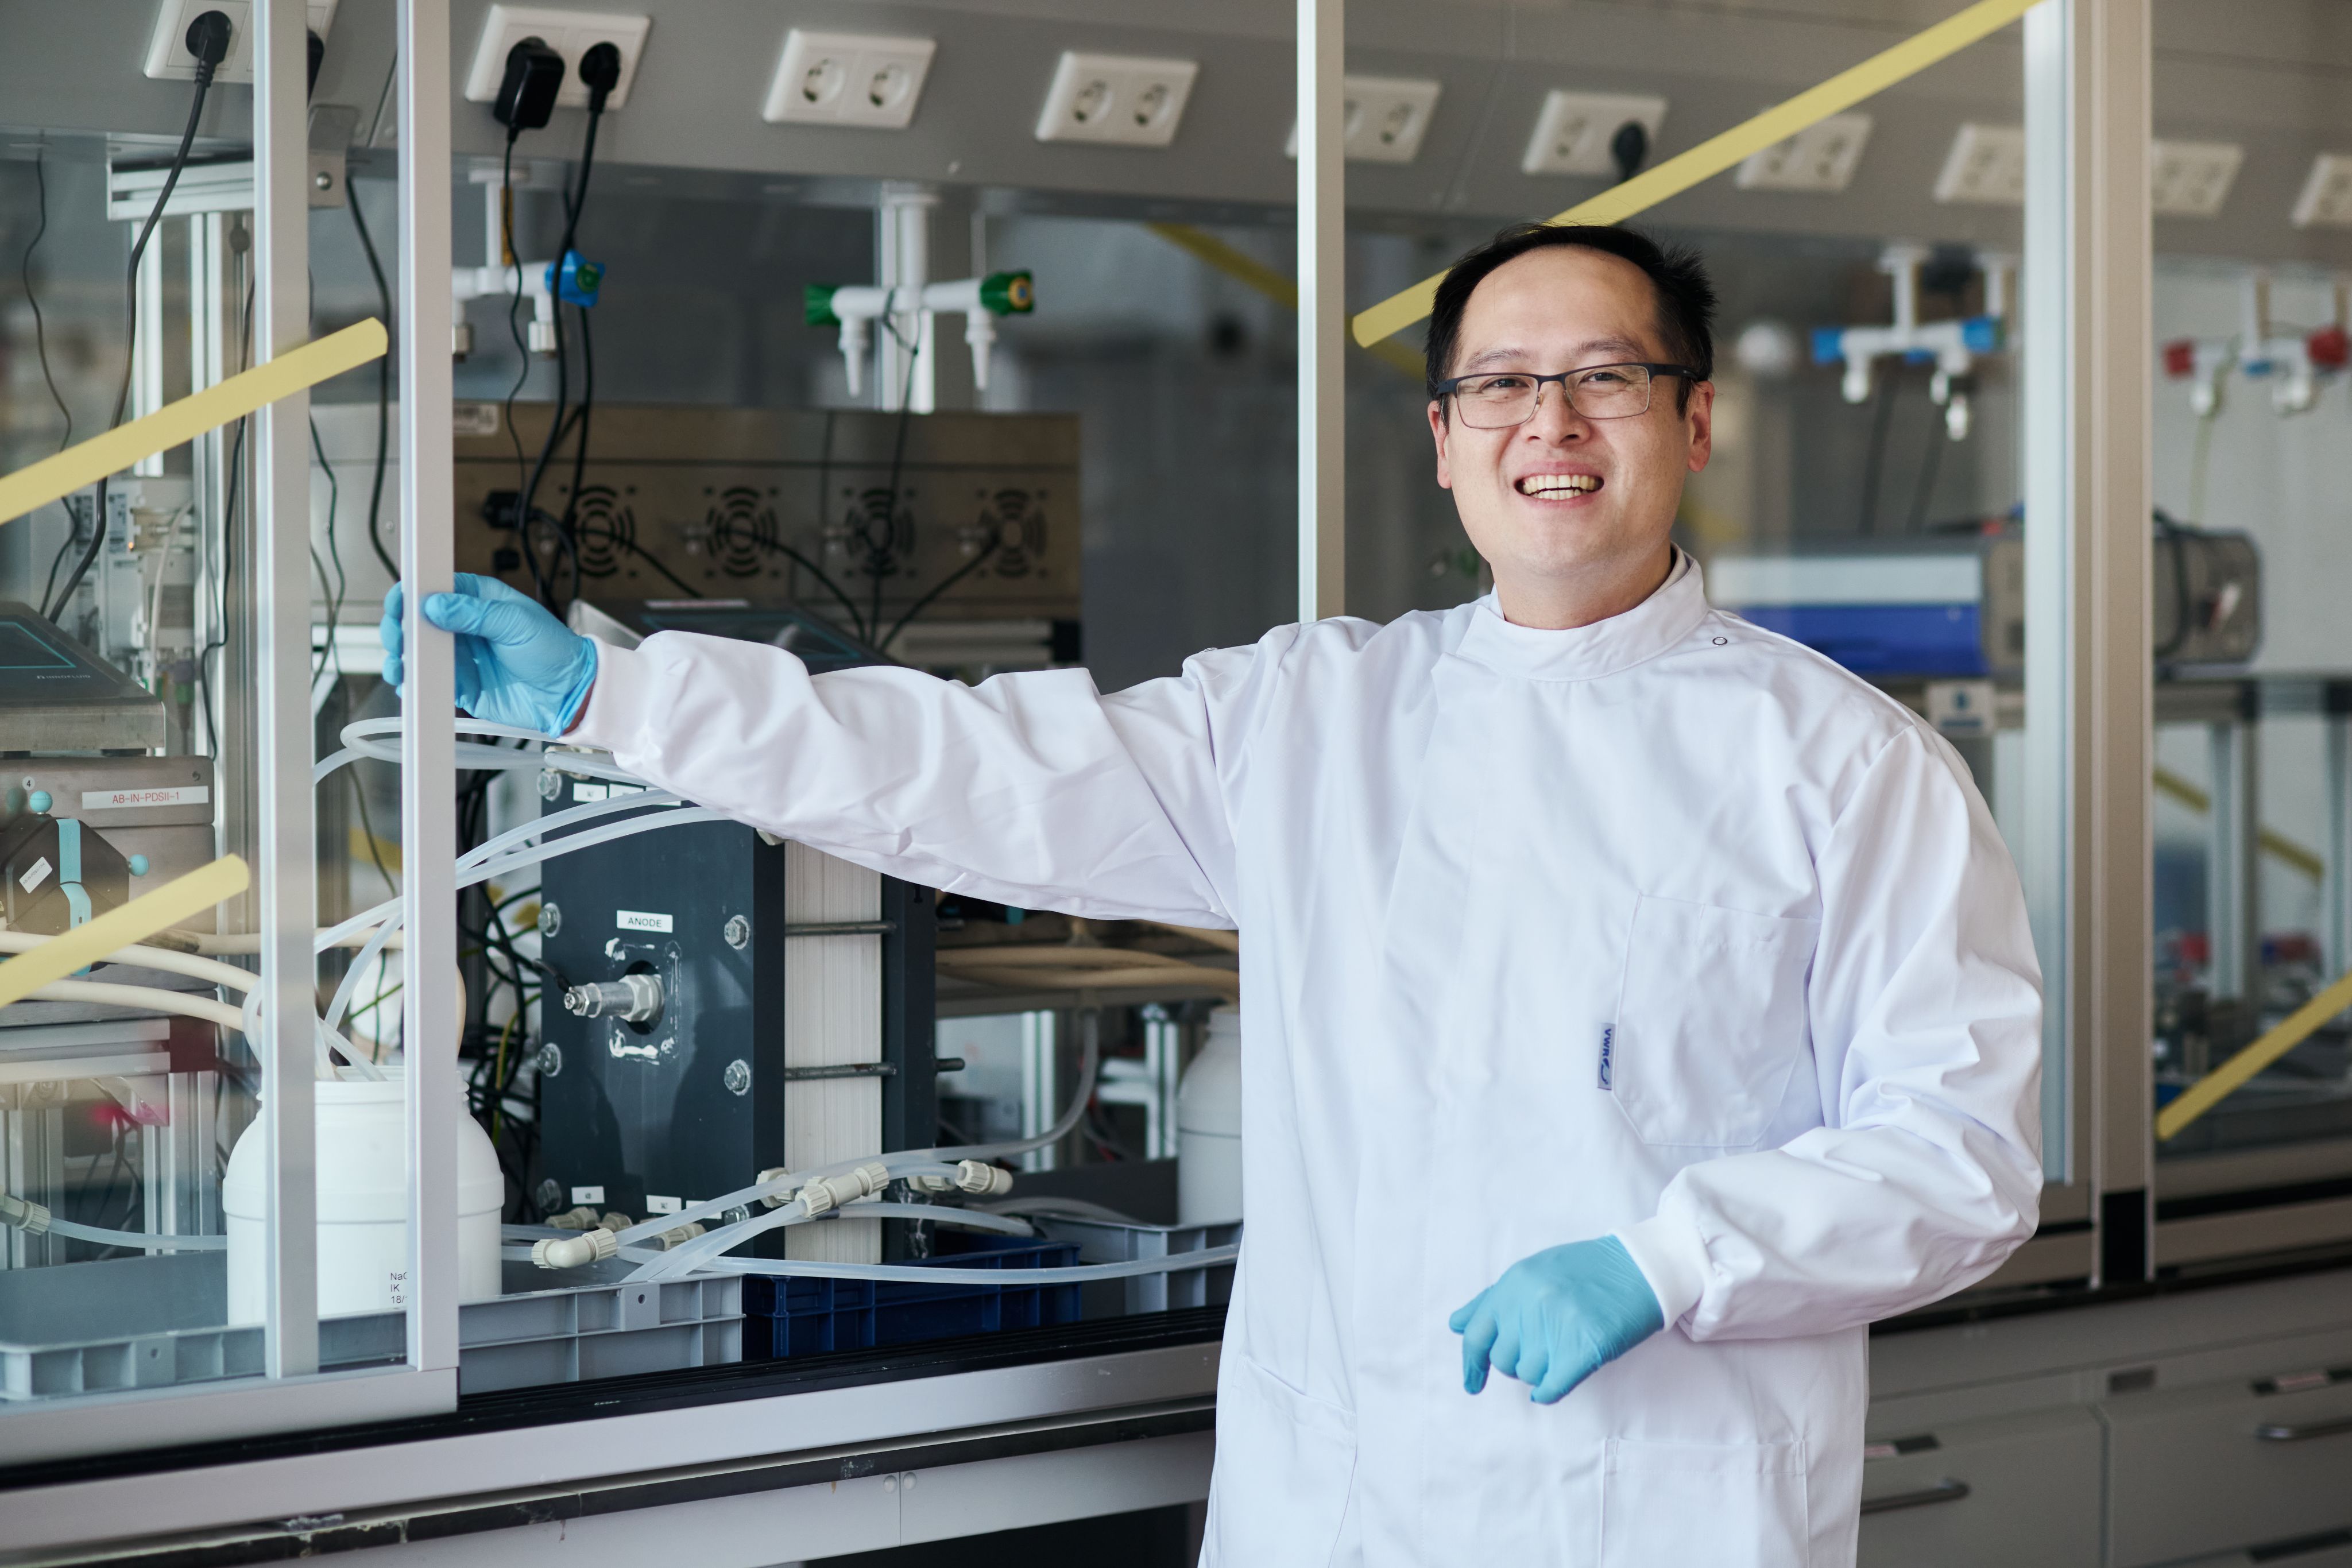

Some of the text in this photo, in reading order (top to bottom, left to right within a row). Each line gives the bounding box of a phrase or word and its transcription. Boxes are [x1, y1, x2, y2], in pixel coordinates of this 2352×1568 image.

[113, 792, 180, 804] AB-IN-PDSII-1
[628, 917, 662, 927] ANODE
[1603, 1028, 1611, 1056] VWR
[390, 1284, 400, 1292] IK
[391, 1295, 408, 1303] 18/
